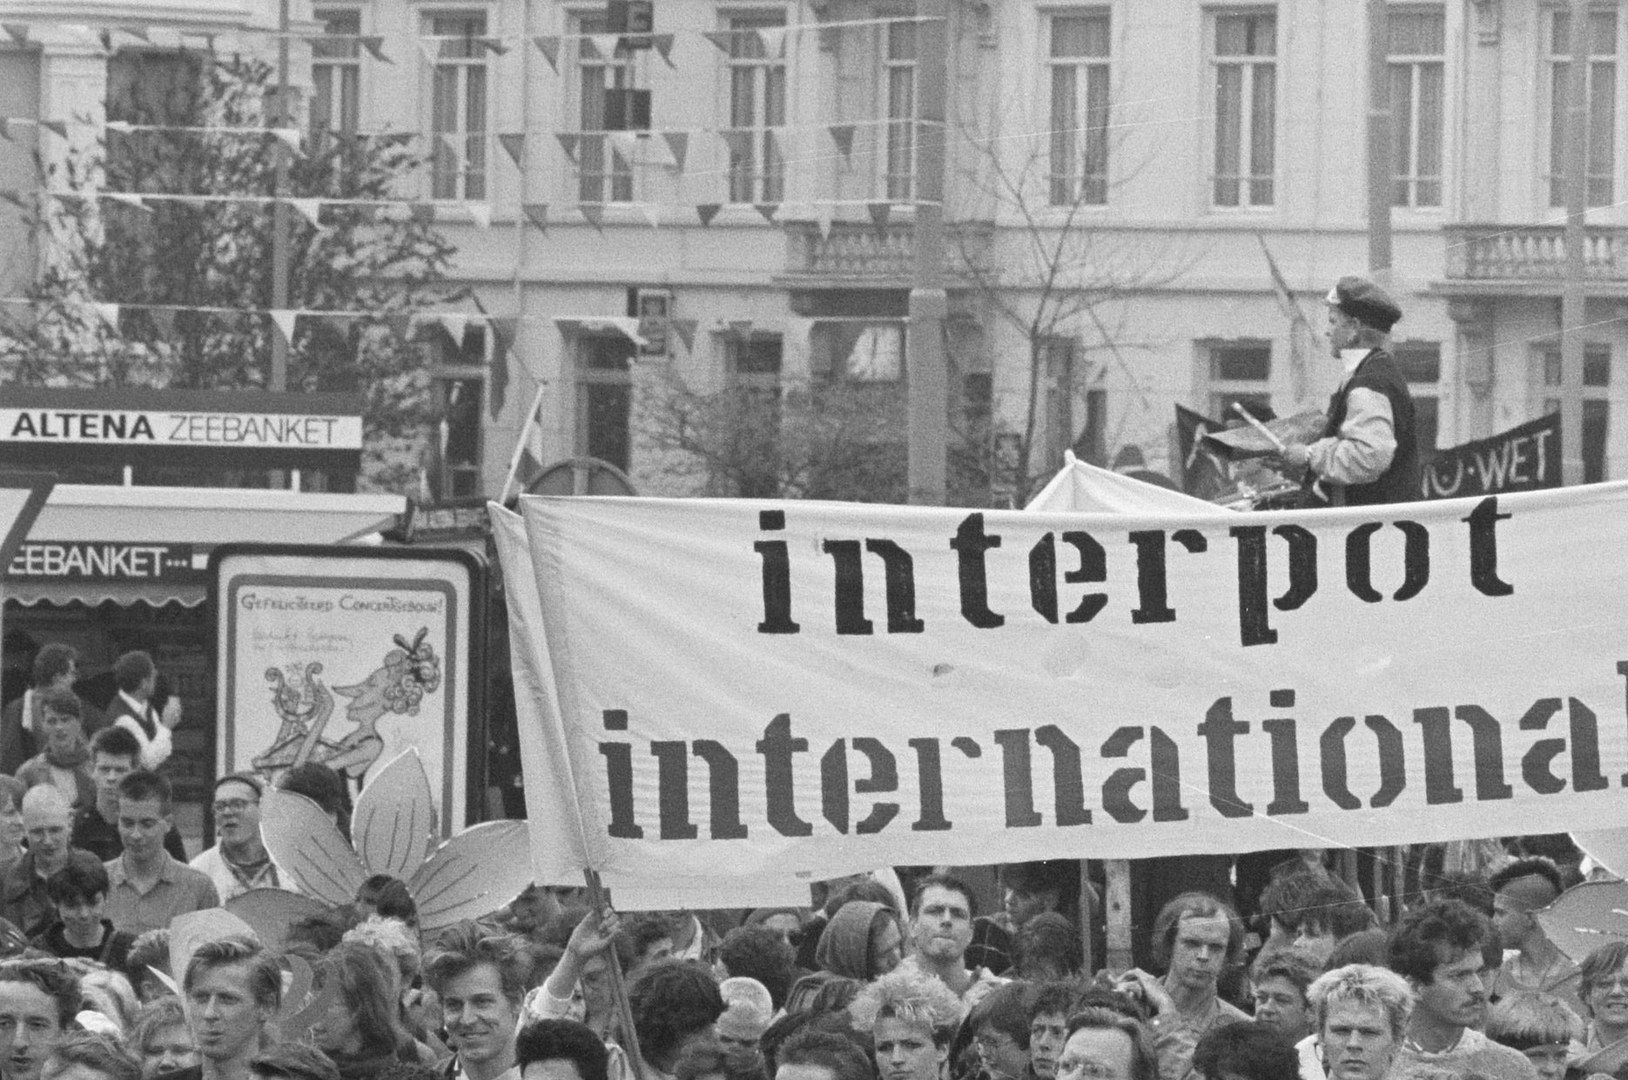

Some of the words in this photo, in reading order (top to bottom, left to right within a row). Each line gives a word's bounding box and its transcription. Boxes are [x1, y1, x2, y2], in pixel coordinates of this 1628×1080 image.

[12, 413, 155, 440] ALTENA
[168, 415, 338, 444] ZEEBANKET
[753, 497, 1515, 646] interpot
